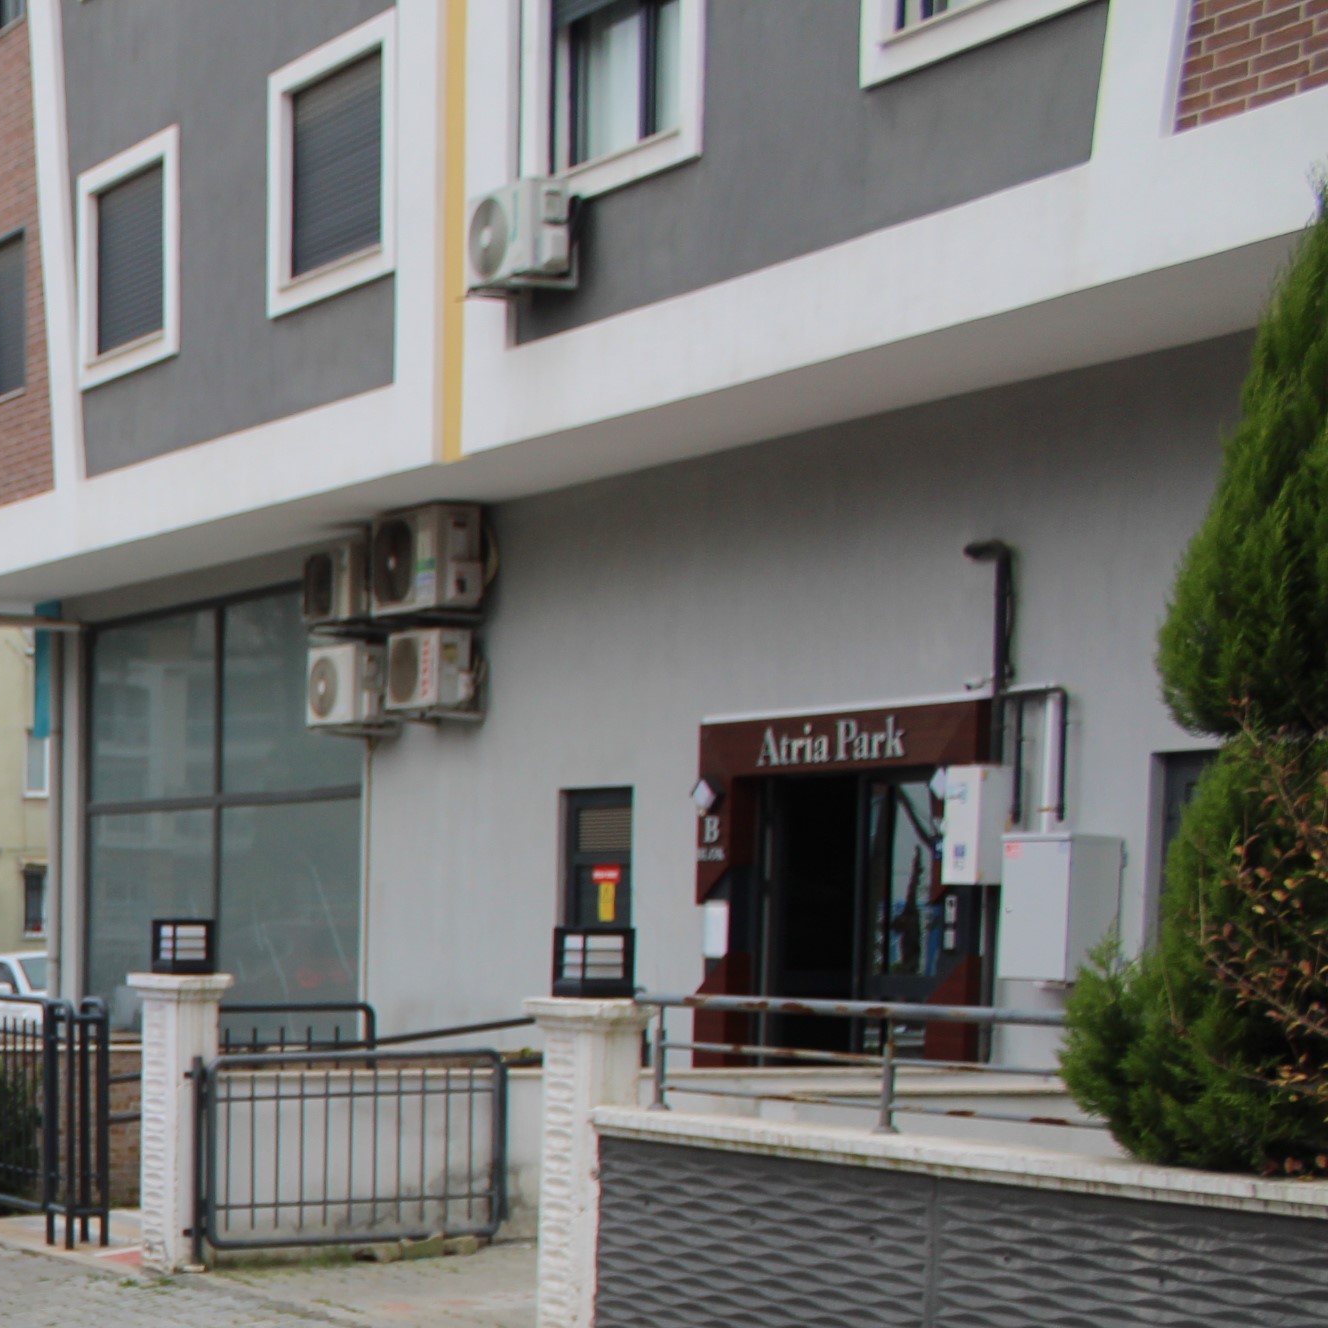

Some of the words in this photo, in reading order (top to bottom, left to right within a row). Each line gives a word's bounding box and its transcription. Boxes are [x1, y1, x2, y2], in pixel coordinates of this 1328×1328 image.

[756, 724, 831, 768] Atria
[835, 716, 906, 762] Park
[703, 815, 720, 843] B
